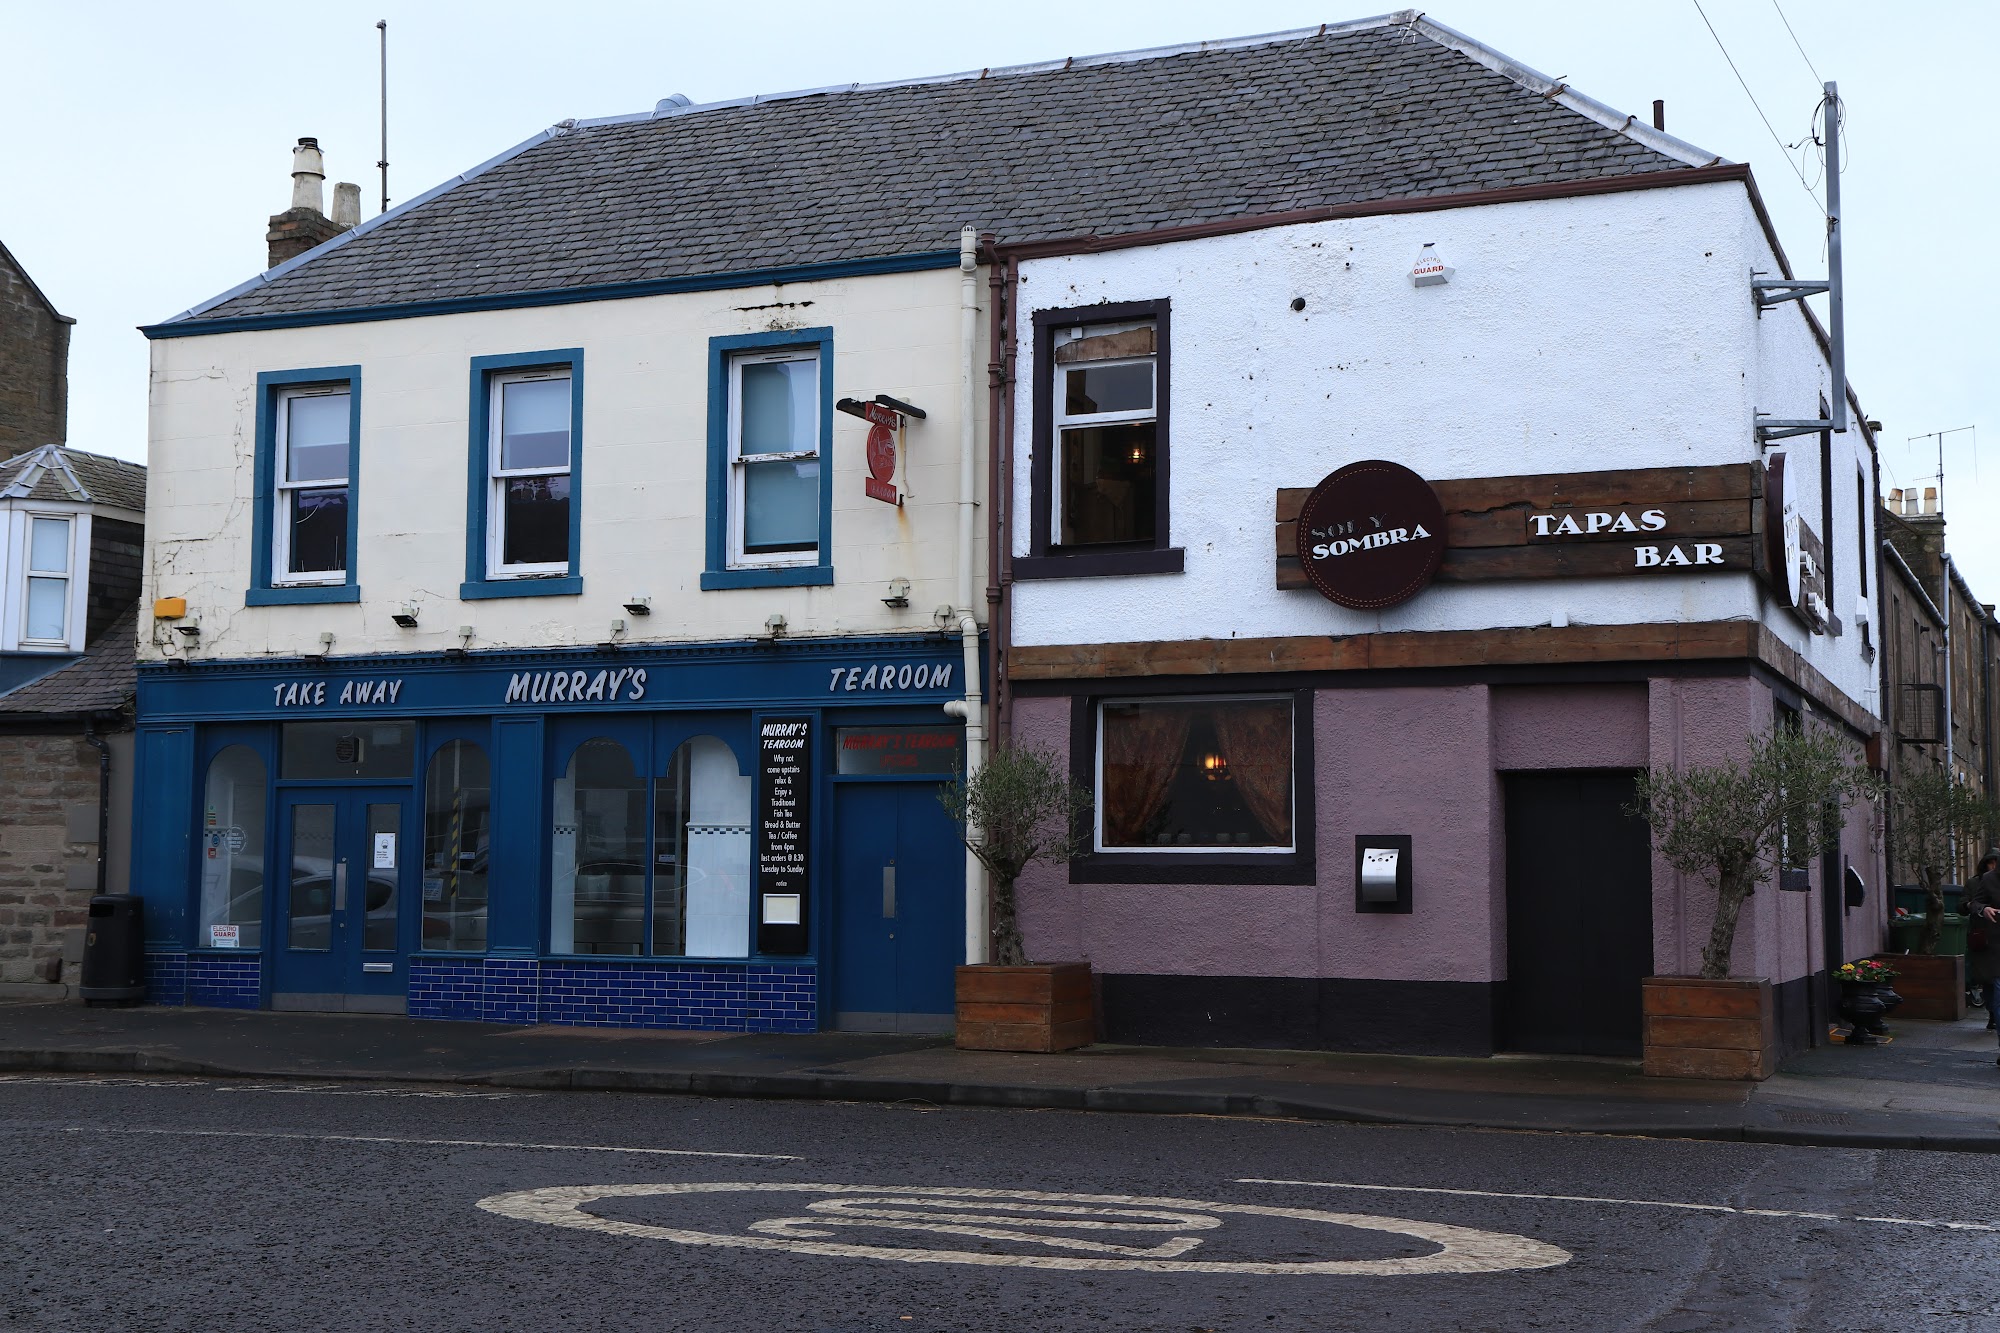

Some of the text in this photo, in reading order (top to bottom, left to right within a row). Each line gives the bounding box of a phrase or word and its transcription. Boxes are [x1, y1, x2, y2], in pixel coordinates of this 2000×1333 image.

[1414, 265, 1443, 274] GUARD
[1311, 512, 1388, 540] SOL Y
[1529, 509, 1667, 536] TAPAS
[1312, 523, 1432, 560] SOMBRA
[1634, 543, 1725, 568] BAR
[829, 663, 953, 692] TEAROOM
[504, 667, 648, 704] MURRAY'S
[273, 679, 403, 707] TAKE AWAY
[761, 722, 808, 737] MURRAY'S
[763, 738, 805, 750] TEAROOM
[773, 753, 785, 765] Why
[781, 765, 800, 776] upstairs
[774, 775, 792, 785] relax &
[774, 787, 787, 798] Enjoy
[771, 797, 796, 807] Traditional
[773, 808, 793, 818] Fish Tea
[764, 820, 801, 829] Bread & Butter
[768, 831, 777, 840] Tea
[781, 830, 798, 840] Coffee
[770, 841, 795, 853] from 4pm
[760, 852, 770, 862] last
[770, 852, 787, 862] orders
[787, 853, 793, 862] @
[761, 864, 805, 876] Tuesday to Sunday
